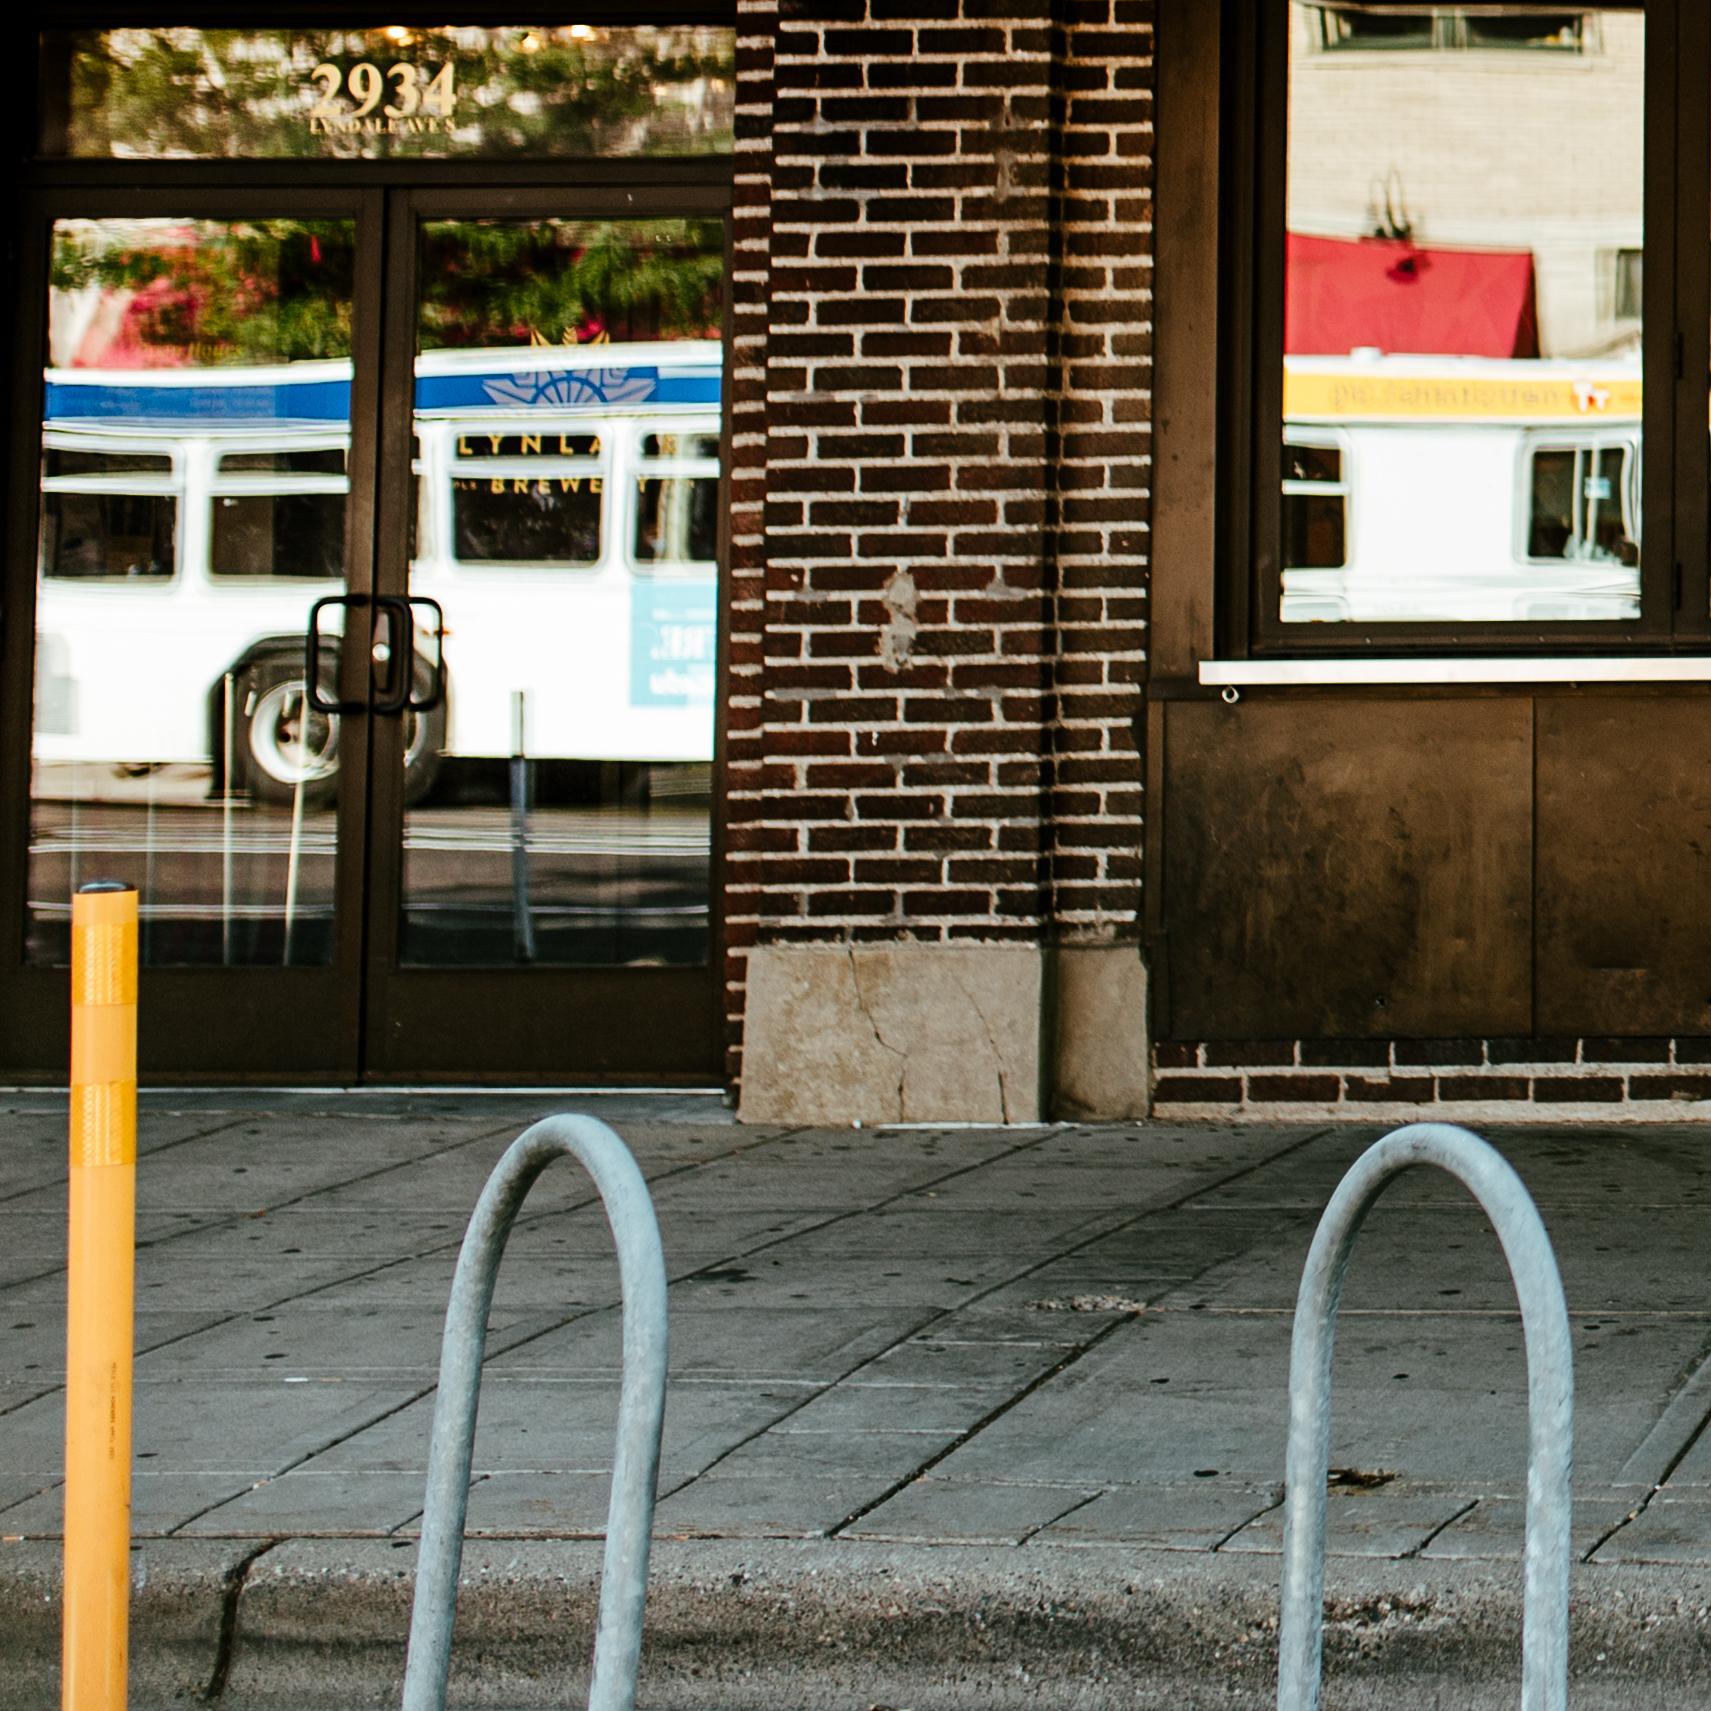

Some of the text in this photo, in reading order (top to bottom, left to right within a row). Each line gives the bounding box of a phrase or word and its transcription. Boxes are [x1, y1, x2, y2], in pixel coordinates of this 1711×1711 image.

[310, 61, 457, 119] 2934
[310, 118, 398, 136] LYNDALE
[407, 117, 439, 134] AVE
[458, 433, 677, 456] LYNLAE
[490, 475, 649, 495] BREWEY
